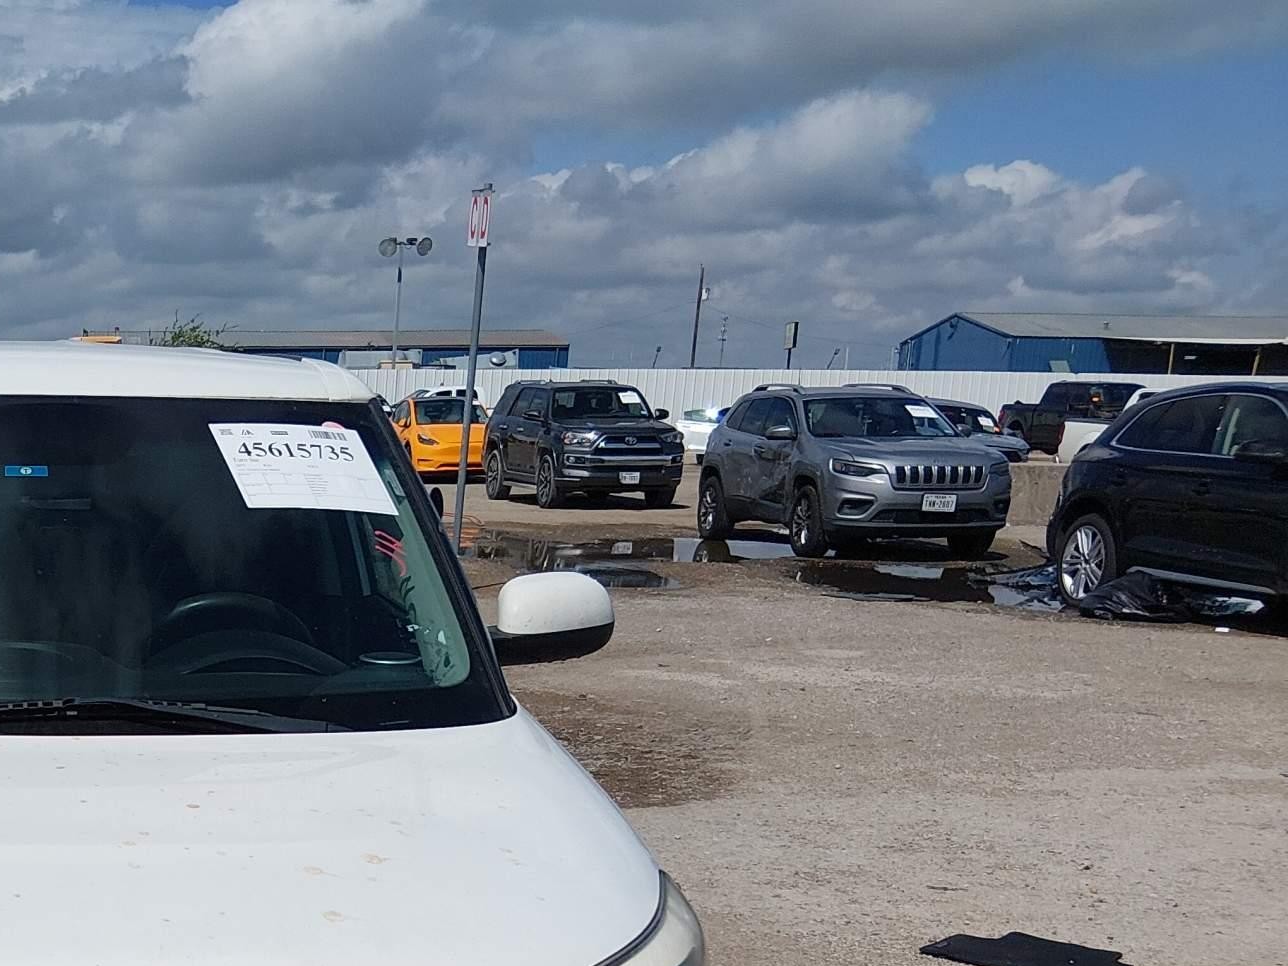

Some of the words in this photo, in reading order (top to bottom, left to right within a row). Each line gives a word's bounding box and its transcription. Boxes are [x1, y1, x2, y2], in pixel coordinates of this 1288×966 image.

[471, 196, 478, 240] C
[480, 196, 489, 240] D
[238, 442, 354, 461] 45615735
